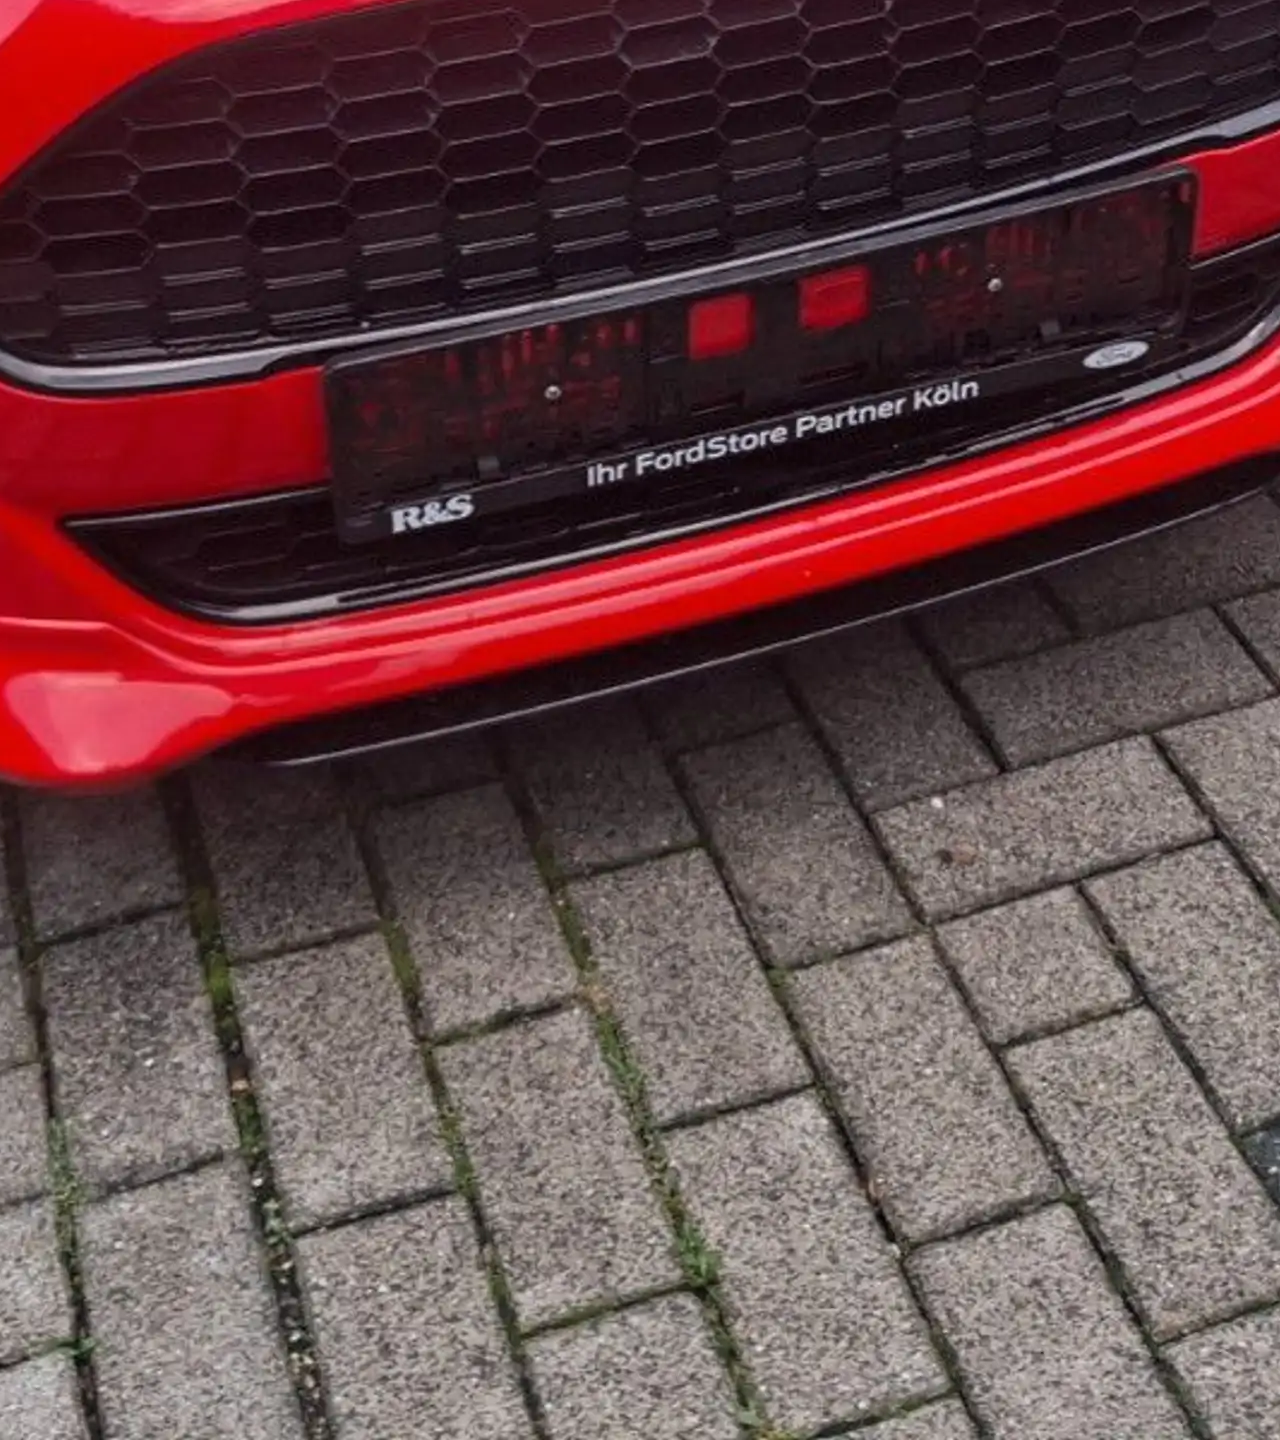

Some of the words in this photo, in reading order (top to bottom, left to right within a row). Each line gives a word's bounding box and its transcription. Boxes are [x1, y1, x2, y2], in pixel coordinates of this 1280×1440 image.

[587, 462, 627, 487] Ihr
[636, 426, 788, 475] FordStore
[796, 396, 907, 438] Partner
[914, 380, 979, 411] Köln
[391, 494, 474, 533] R&S
